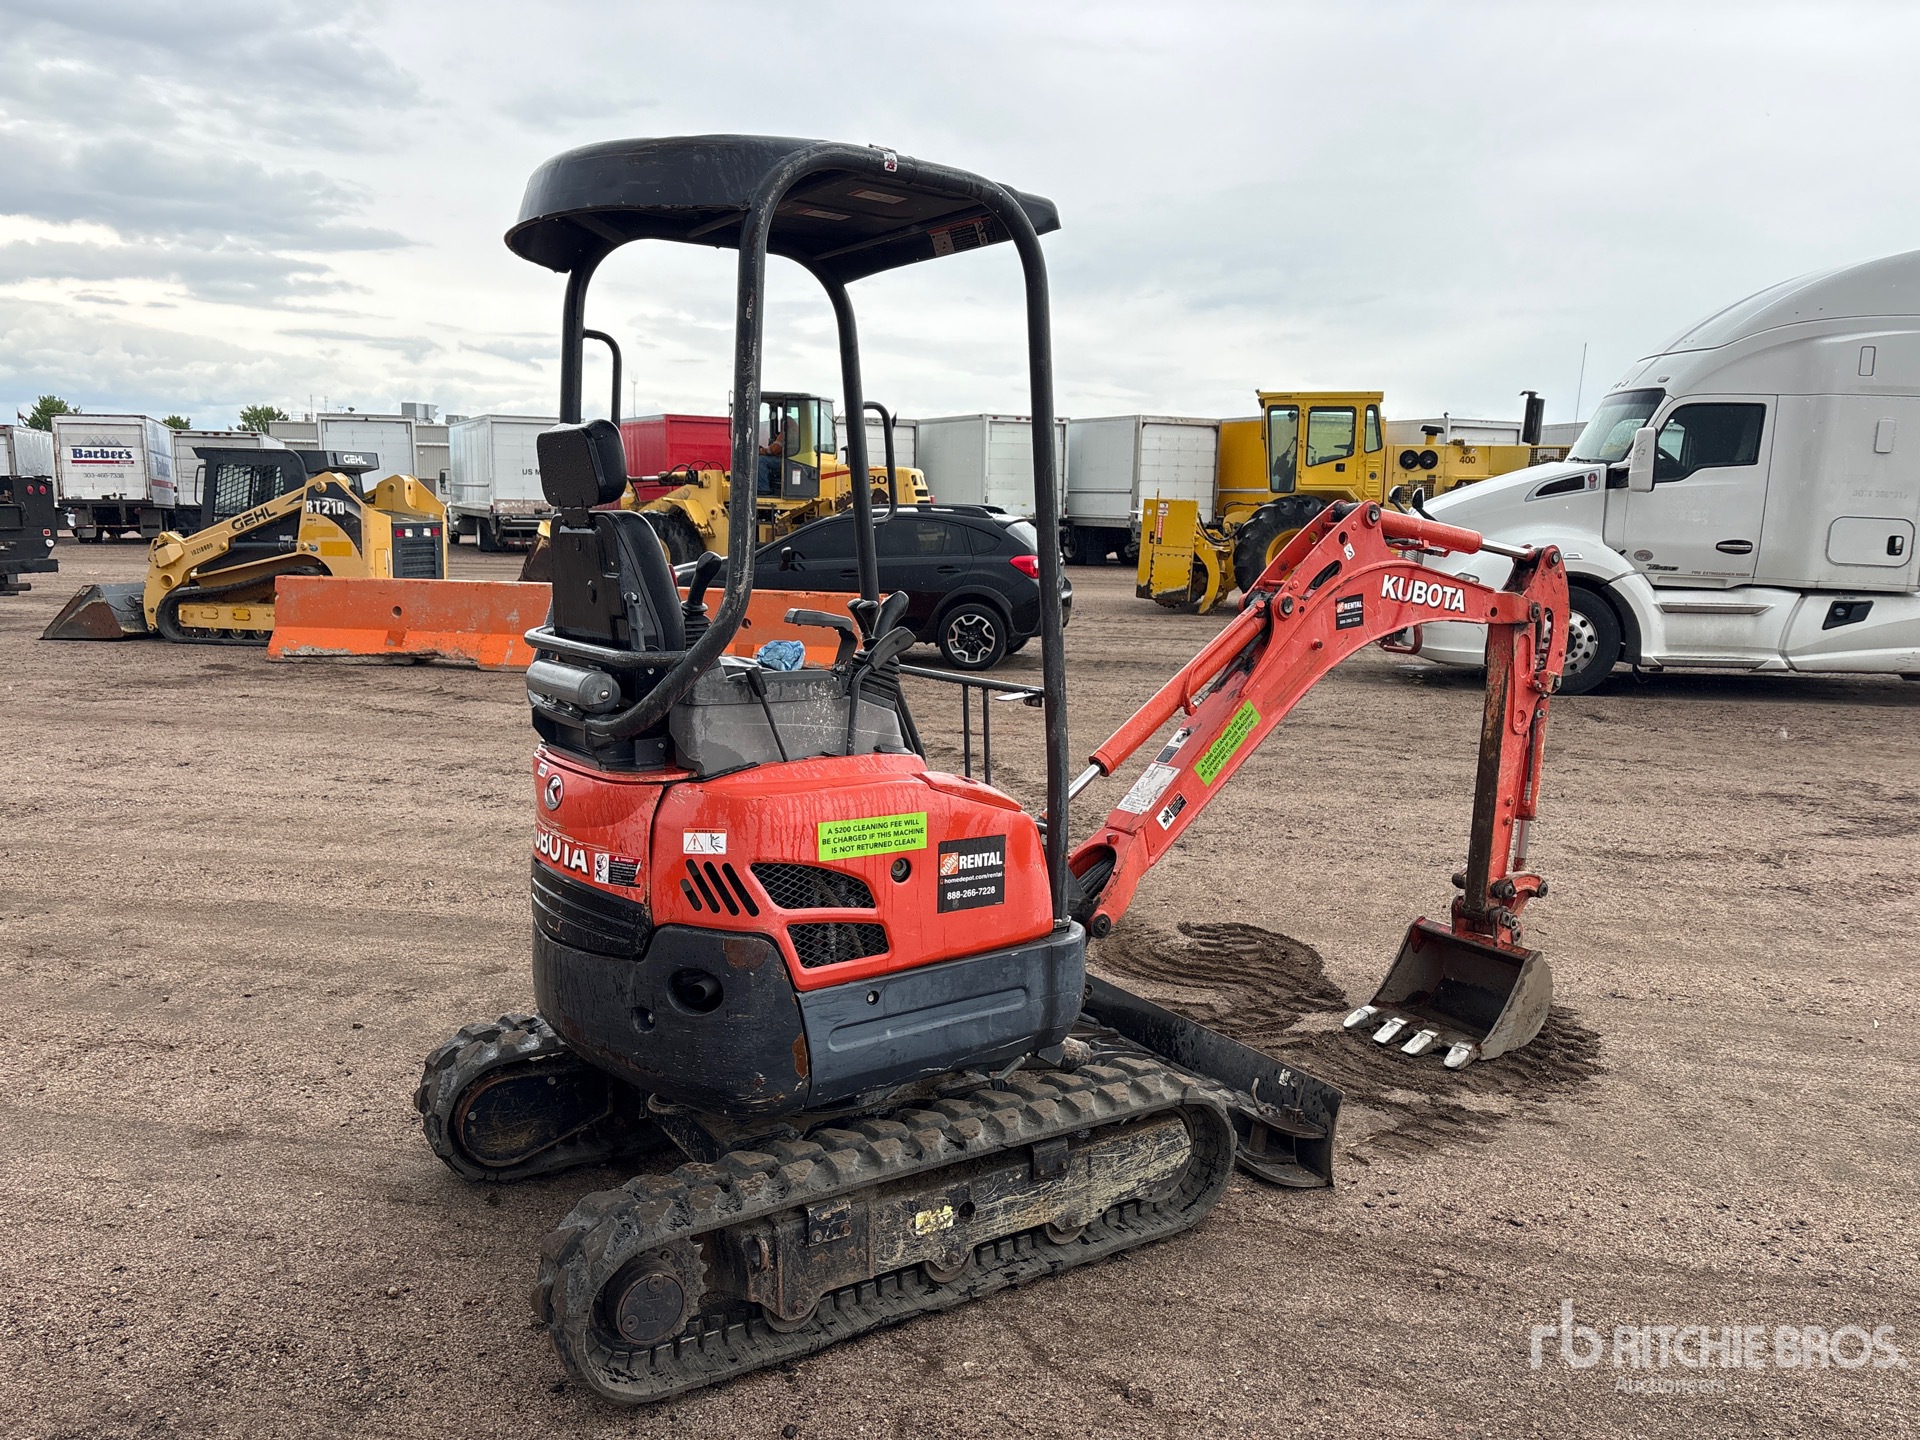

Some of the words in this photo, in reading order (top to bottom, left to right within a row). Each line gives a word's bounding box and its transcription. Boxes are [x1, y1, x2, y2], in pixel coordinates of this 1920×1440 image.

[71, 448, 132, 459] Barber's
[343, 454, 367, 465] GEHL
[1459, 456, 1476, 464] 400
[306, 500, 345, 516] RT210
[231, 506, 278, 531] GEHL
[1381, 574, 1465, 612] KUBOTA
[1343, 600, 1363, 610] RENTAL
[1212, 729, 1232, 754] CLEANING
[1231, 719, 1240, 730] FEE
[1220, 735, 1242, 761] RETURNED
[1206, 746, 1226, 770] CHARGED
[835, 826, 851, 834] $200
[853, 822, 889, 832] CLEANING
[890, 820, 903, 828] FEE
[833, 834, 867, 844] CHARGED
[893, 828, 925, 837] MACHINE
[535, 828, 589, 875] UBOTA
[840, 845, 854, 853] NOT
[857, 840, 893, 851] RETURNED
[894, 838, 916, 846] CLEAN
[959, 851, 1003, 870] RENTAL
[944, 871, 1003, 884] homedepot.com/rental
[946, 886, 996, 900] 888-266-7228
